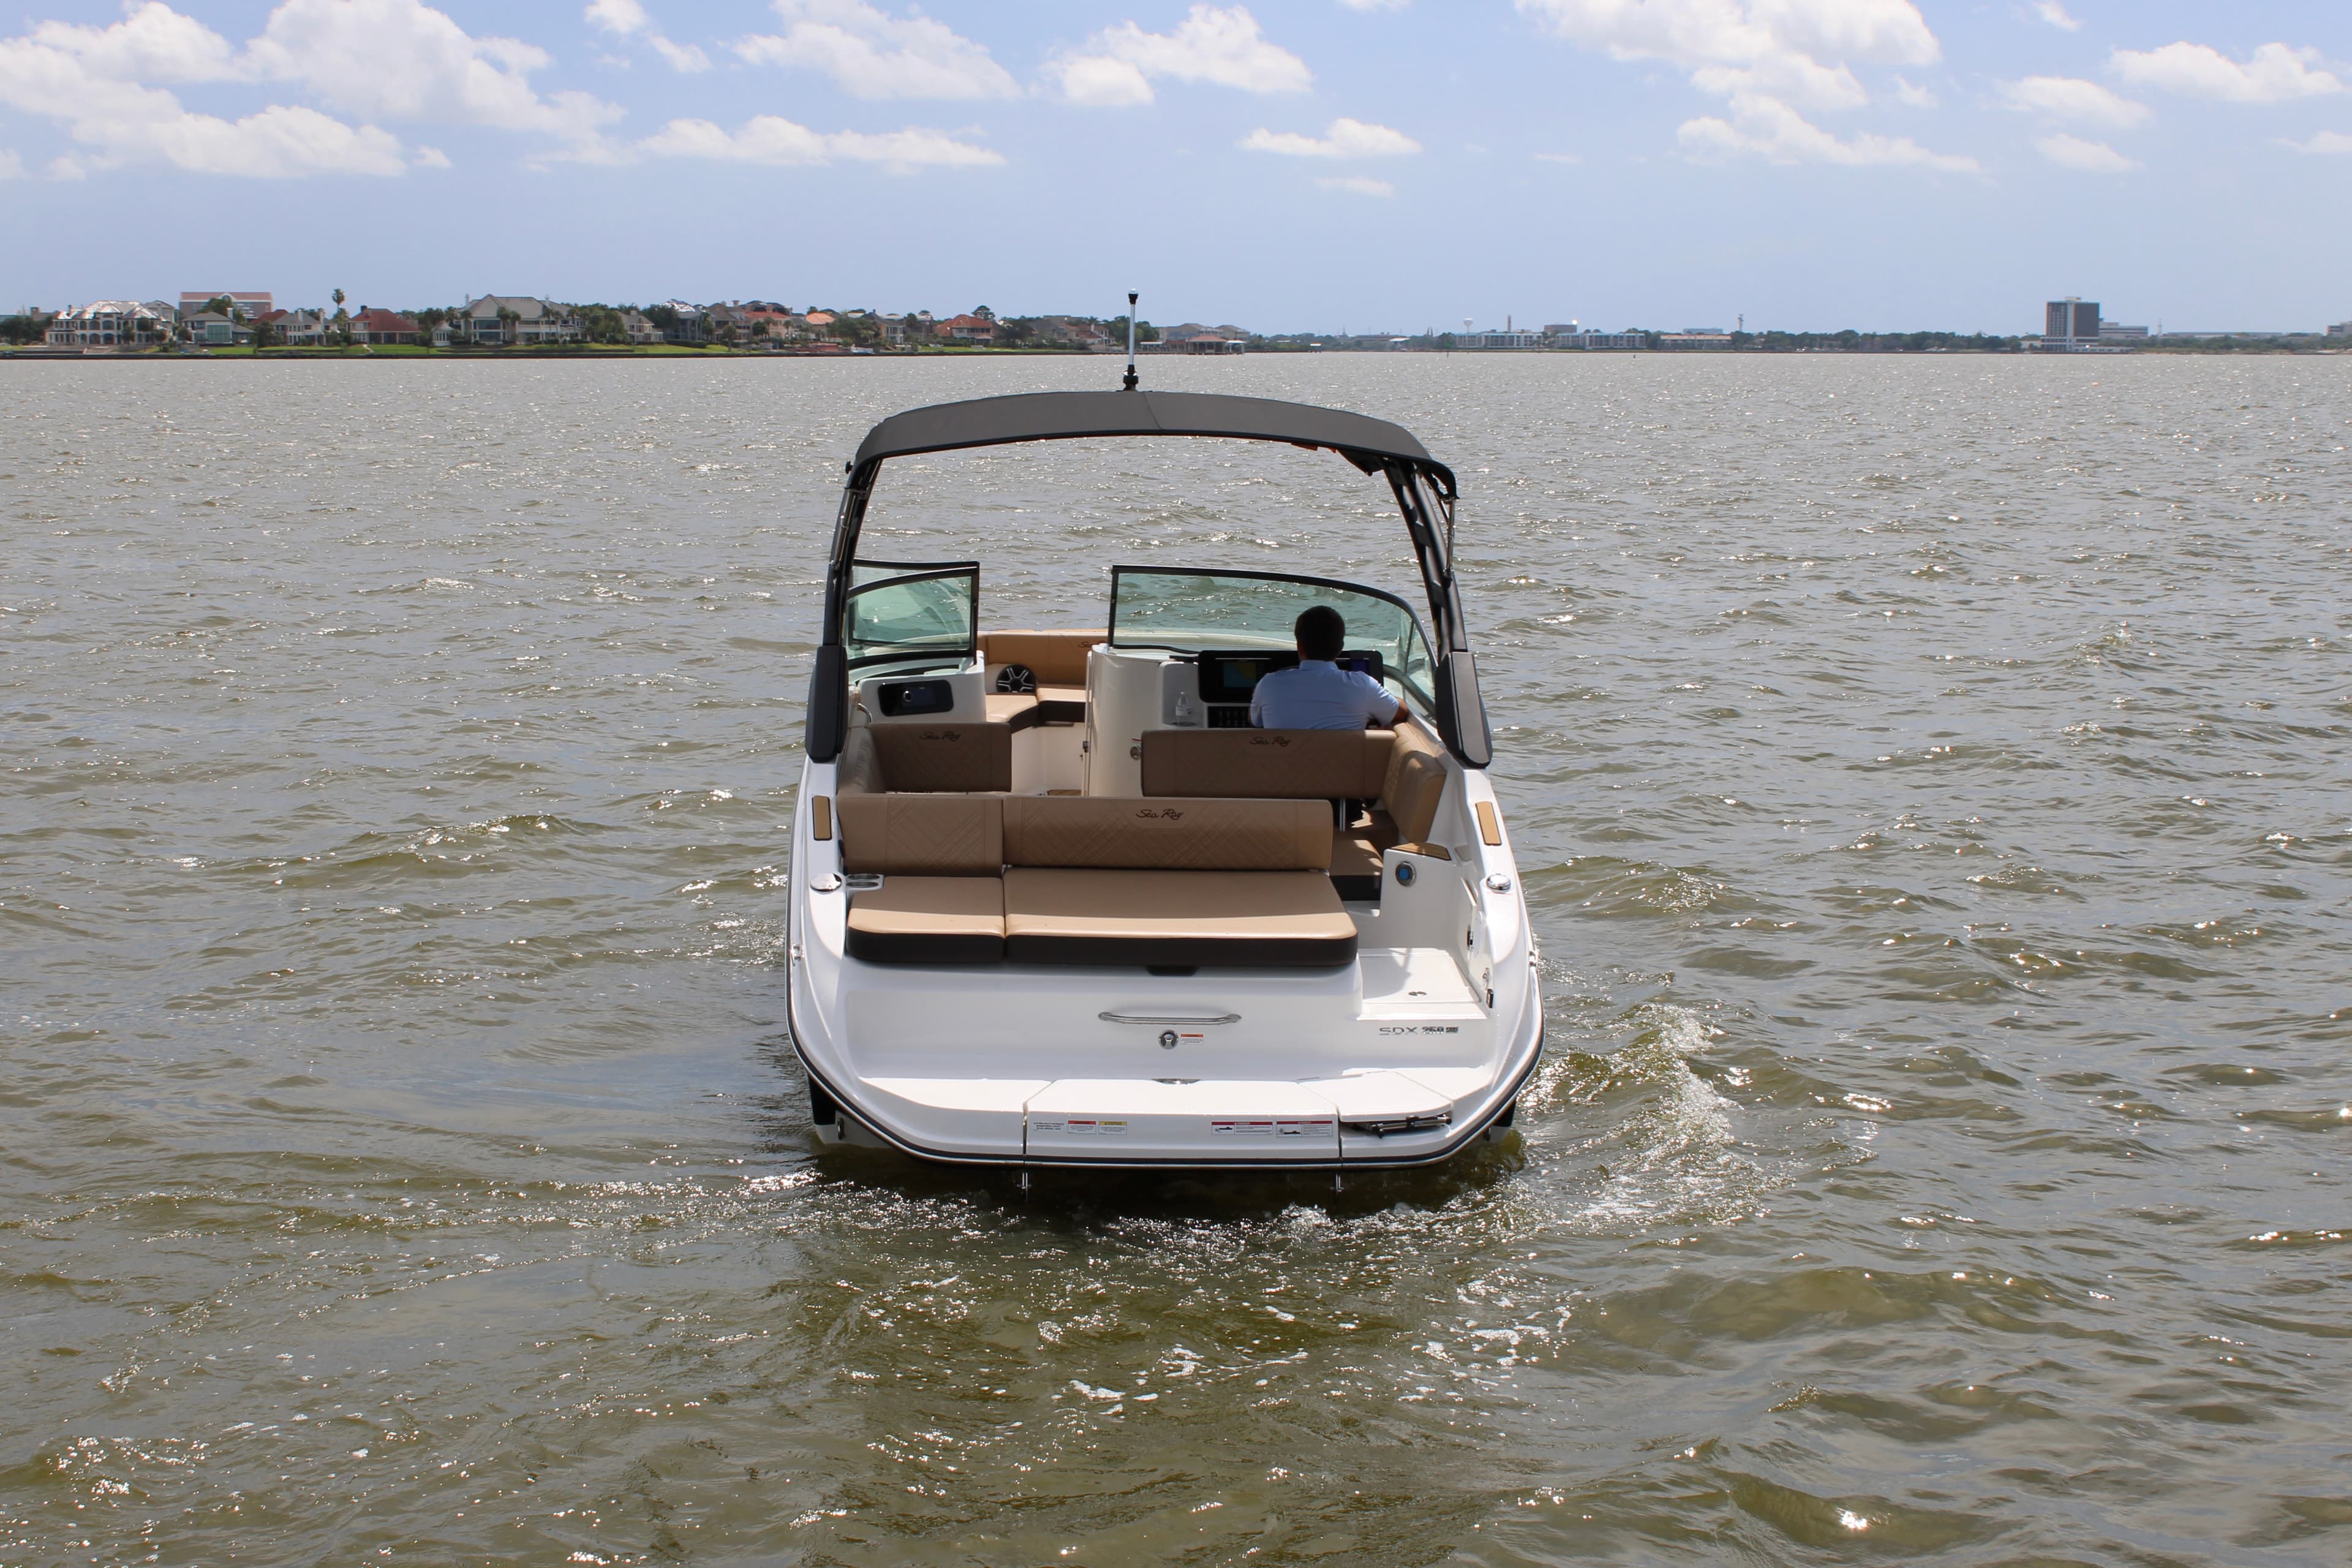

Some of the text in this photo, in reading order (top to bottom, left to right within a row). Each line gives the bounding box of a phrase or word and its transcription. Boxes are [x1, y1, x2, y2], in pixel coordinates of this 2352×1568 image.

[1136, 808, 1184, 820] Sea Ray
[1379, 1027, 1418, 1035] SDX
